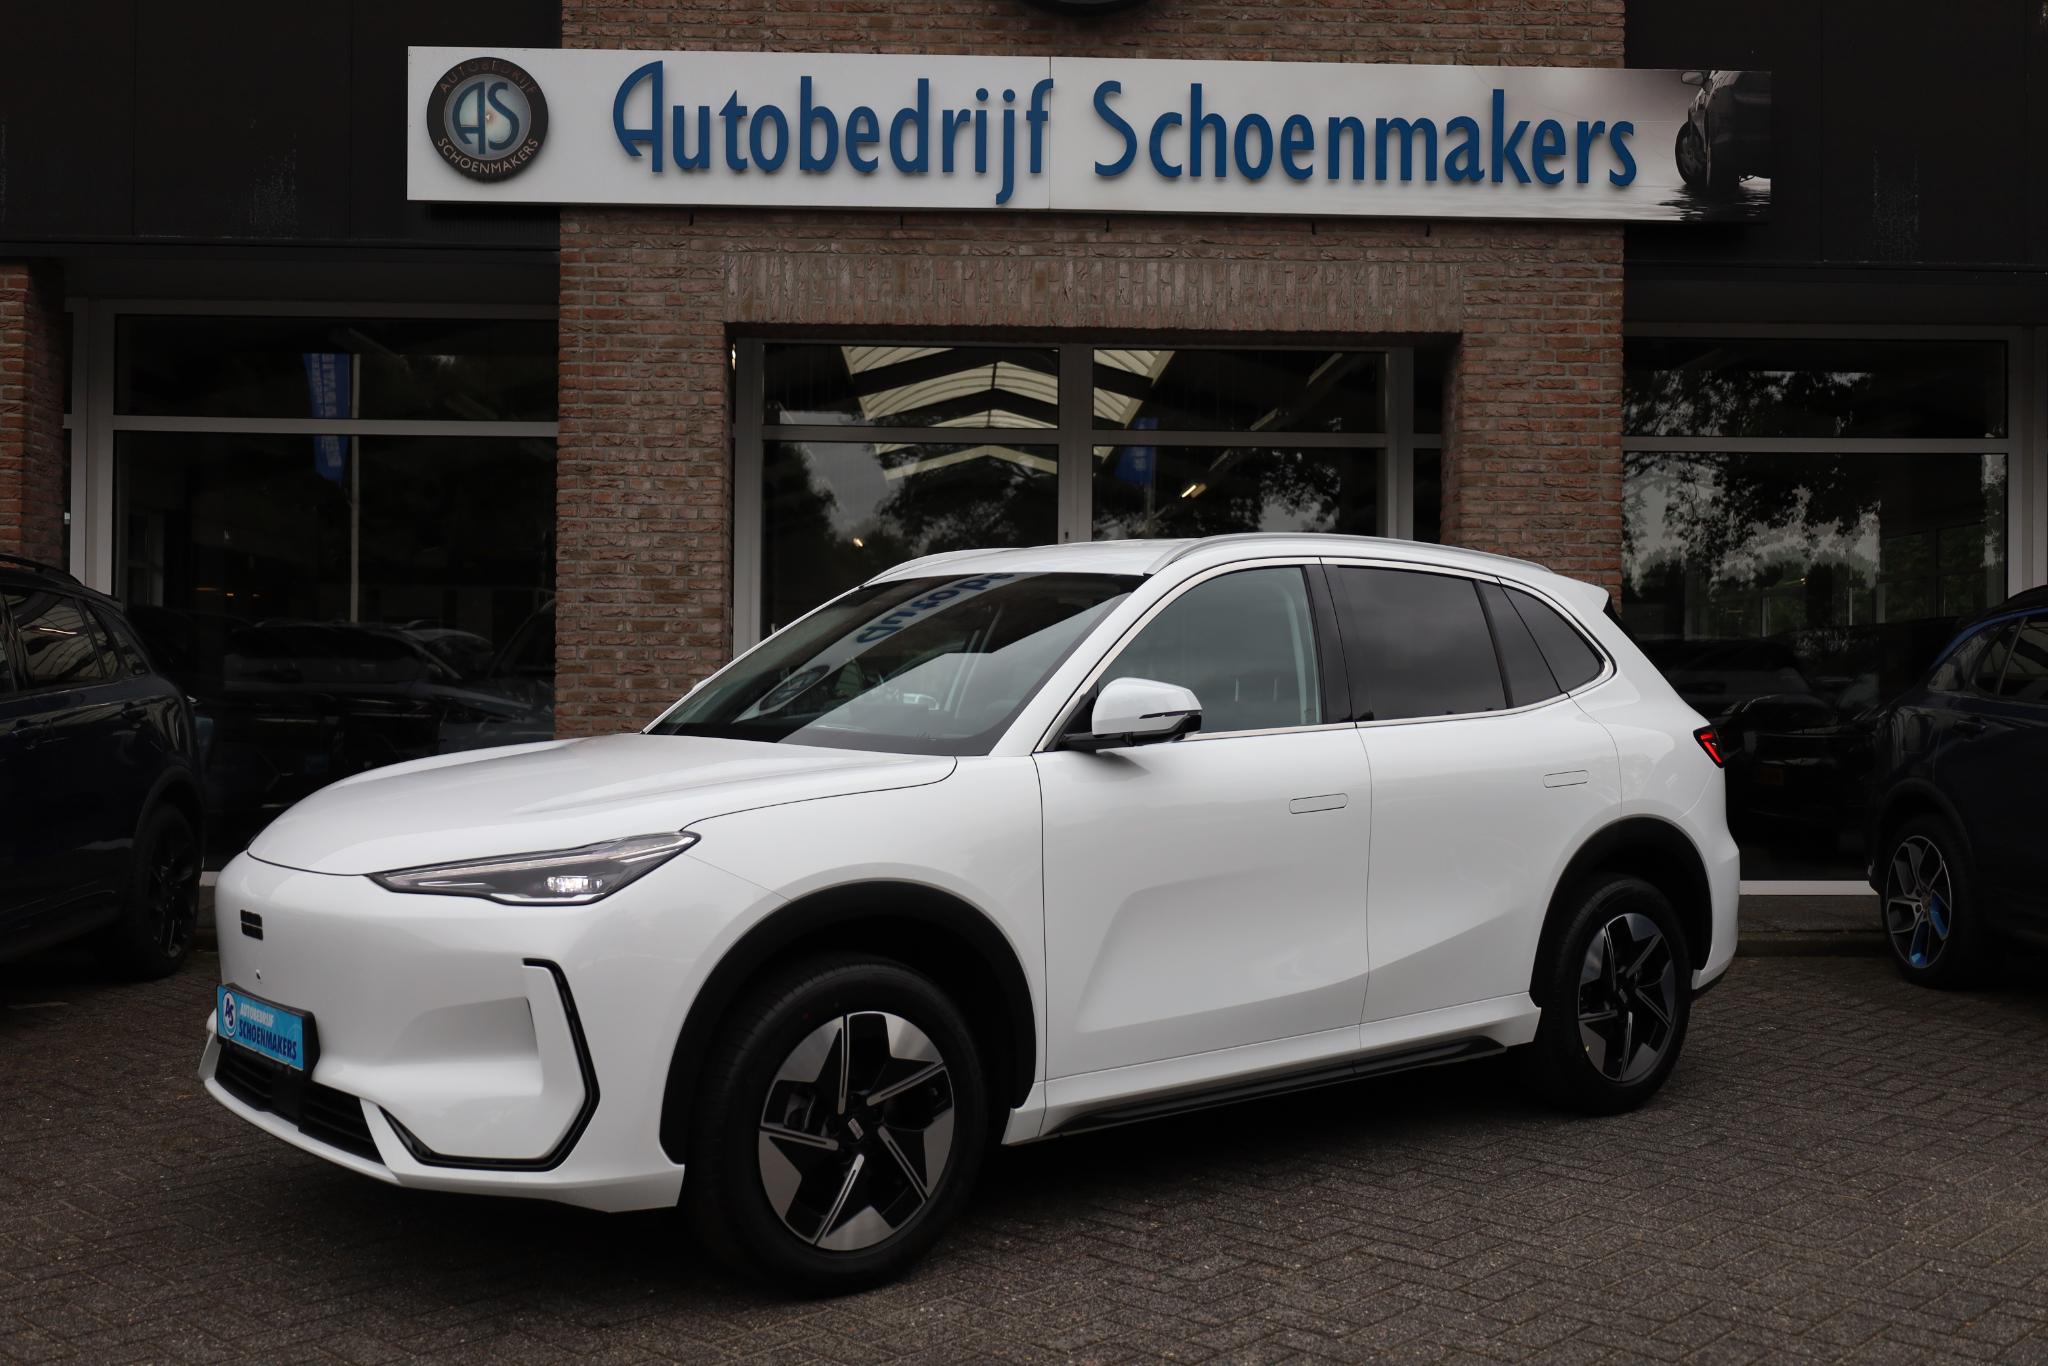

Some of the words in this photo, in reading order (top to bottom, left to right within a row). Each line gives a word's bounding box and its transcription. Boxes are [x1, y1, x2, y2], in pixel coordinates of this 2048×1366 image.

[452, 80, 520, 155] AS
[613, 60, 1054, 205] Autobedrijf
[1093, 80, 1637, 187] Schoenmakers
[438, 137, 539, 175] SCHOENMAKERS
[239, 1019, 297, 1060] SCHOENMAKERS
